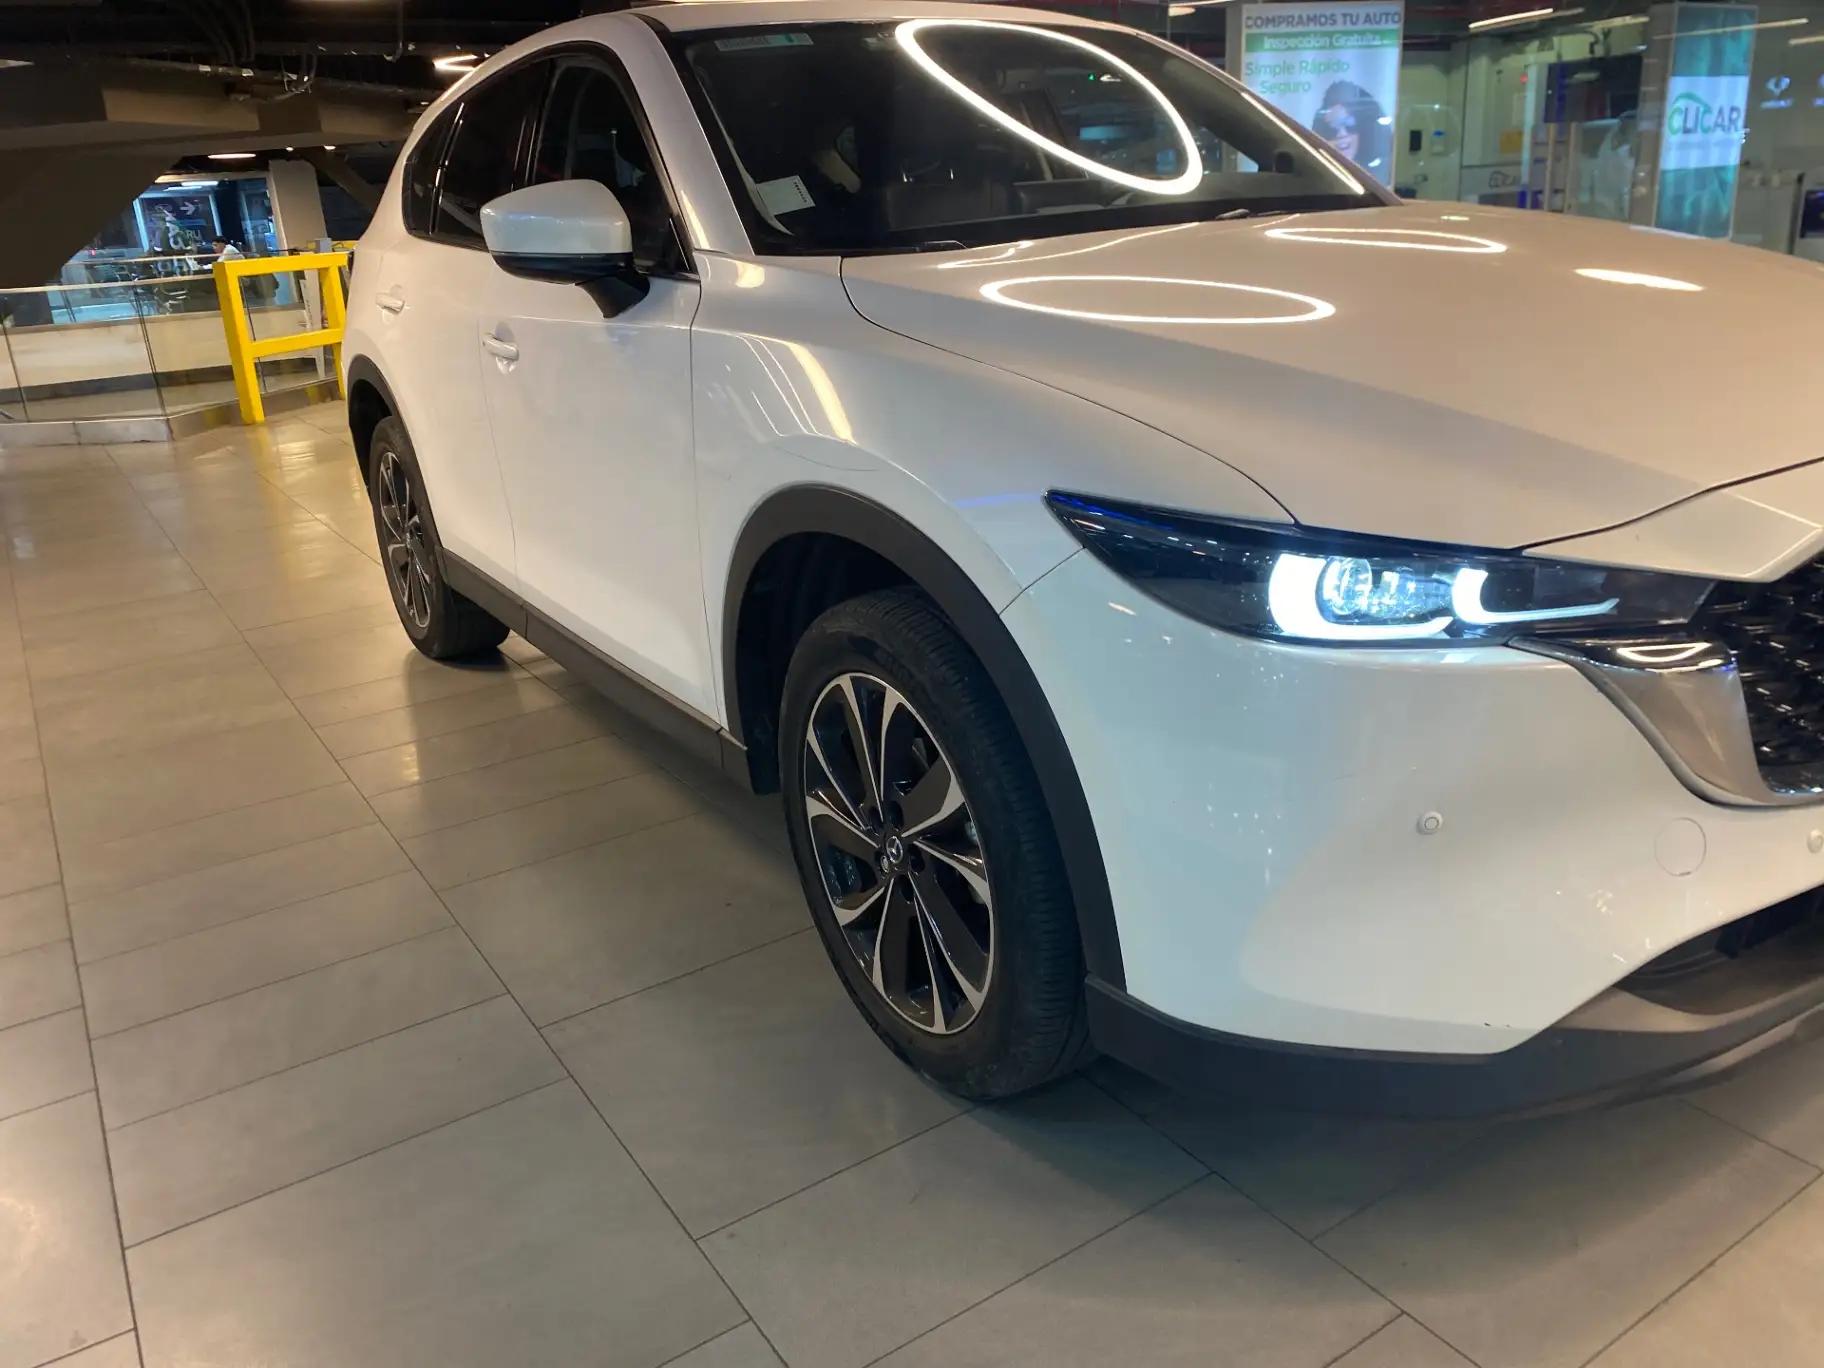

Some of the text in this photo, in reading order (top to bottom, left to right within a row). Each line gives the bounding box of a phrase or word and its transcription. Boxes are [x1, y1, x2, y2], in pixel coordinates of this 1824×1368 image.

[1244, 12, 1401, 29] COMPRAMOS TU AUTO
[1245, 60, 1295, 78] Simple
[1260, 82, 1311, 95] Seguro
[1668, 100, 1741, 135] CLICAR
